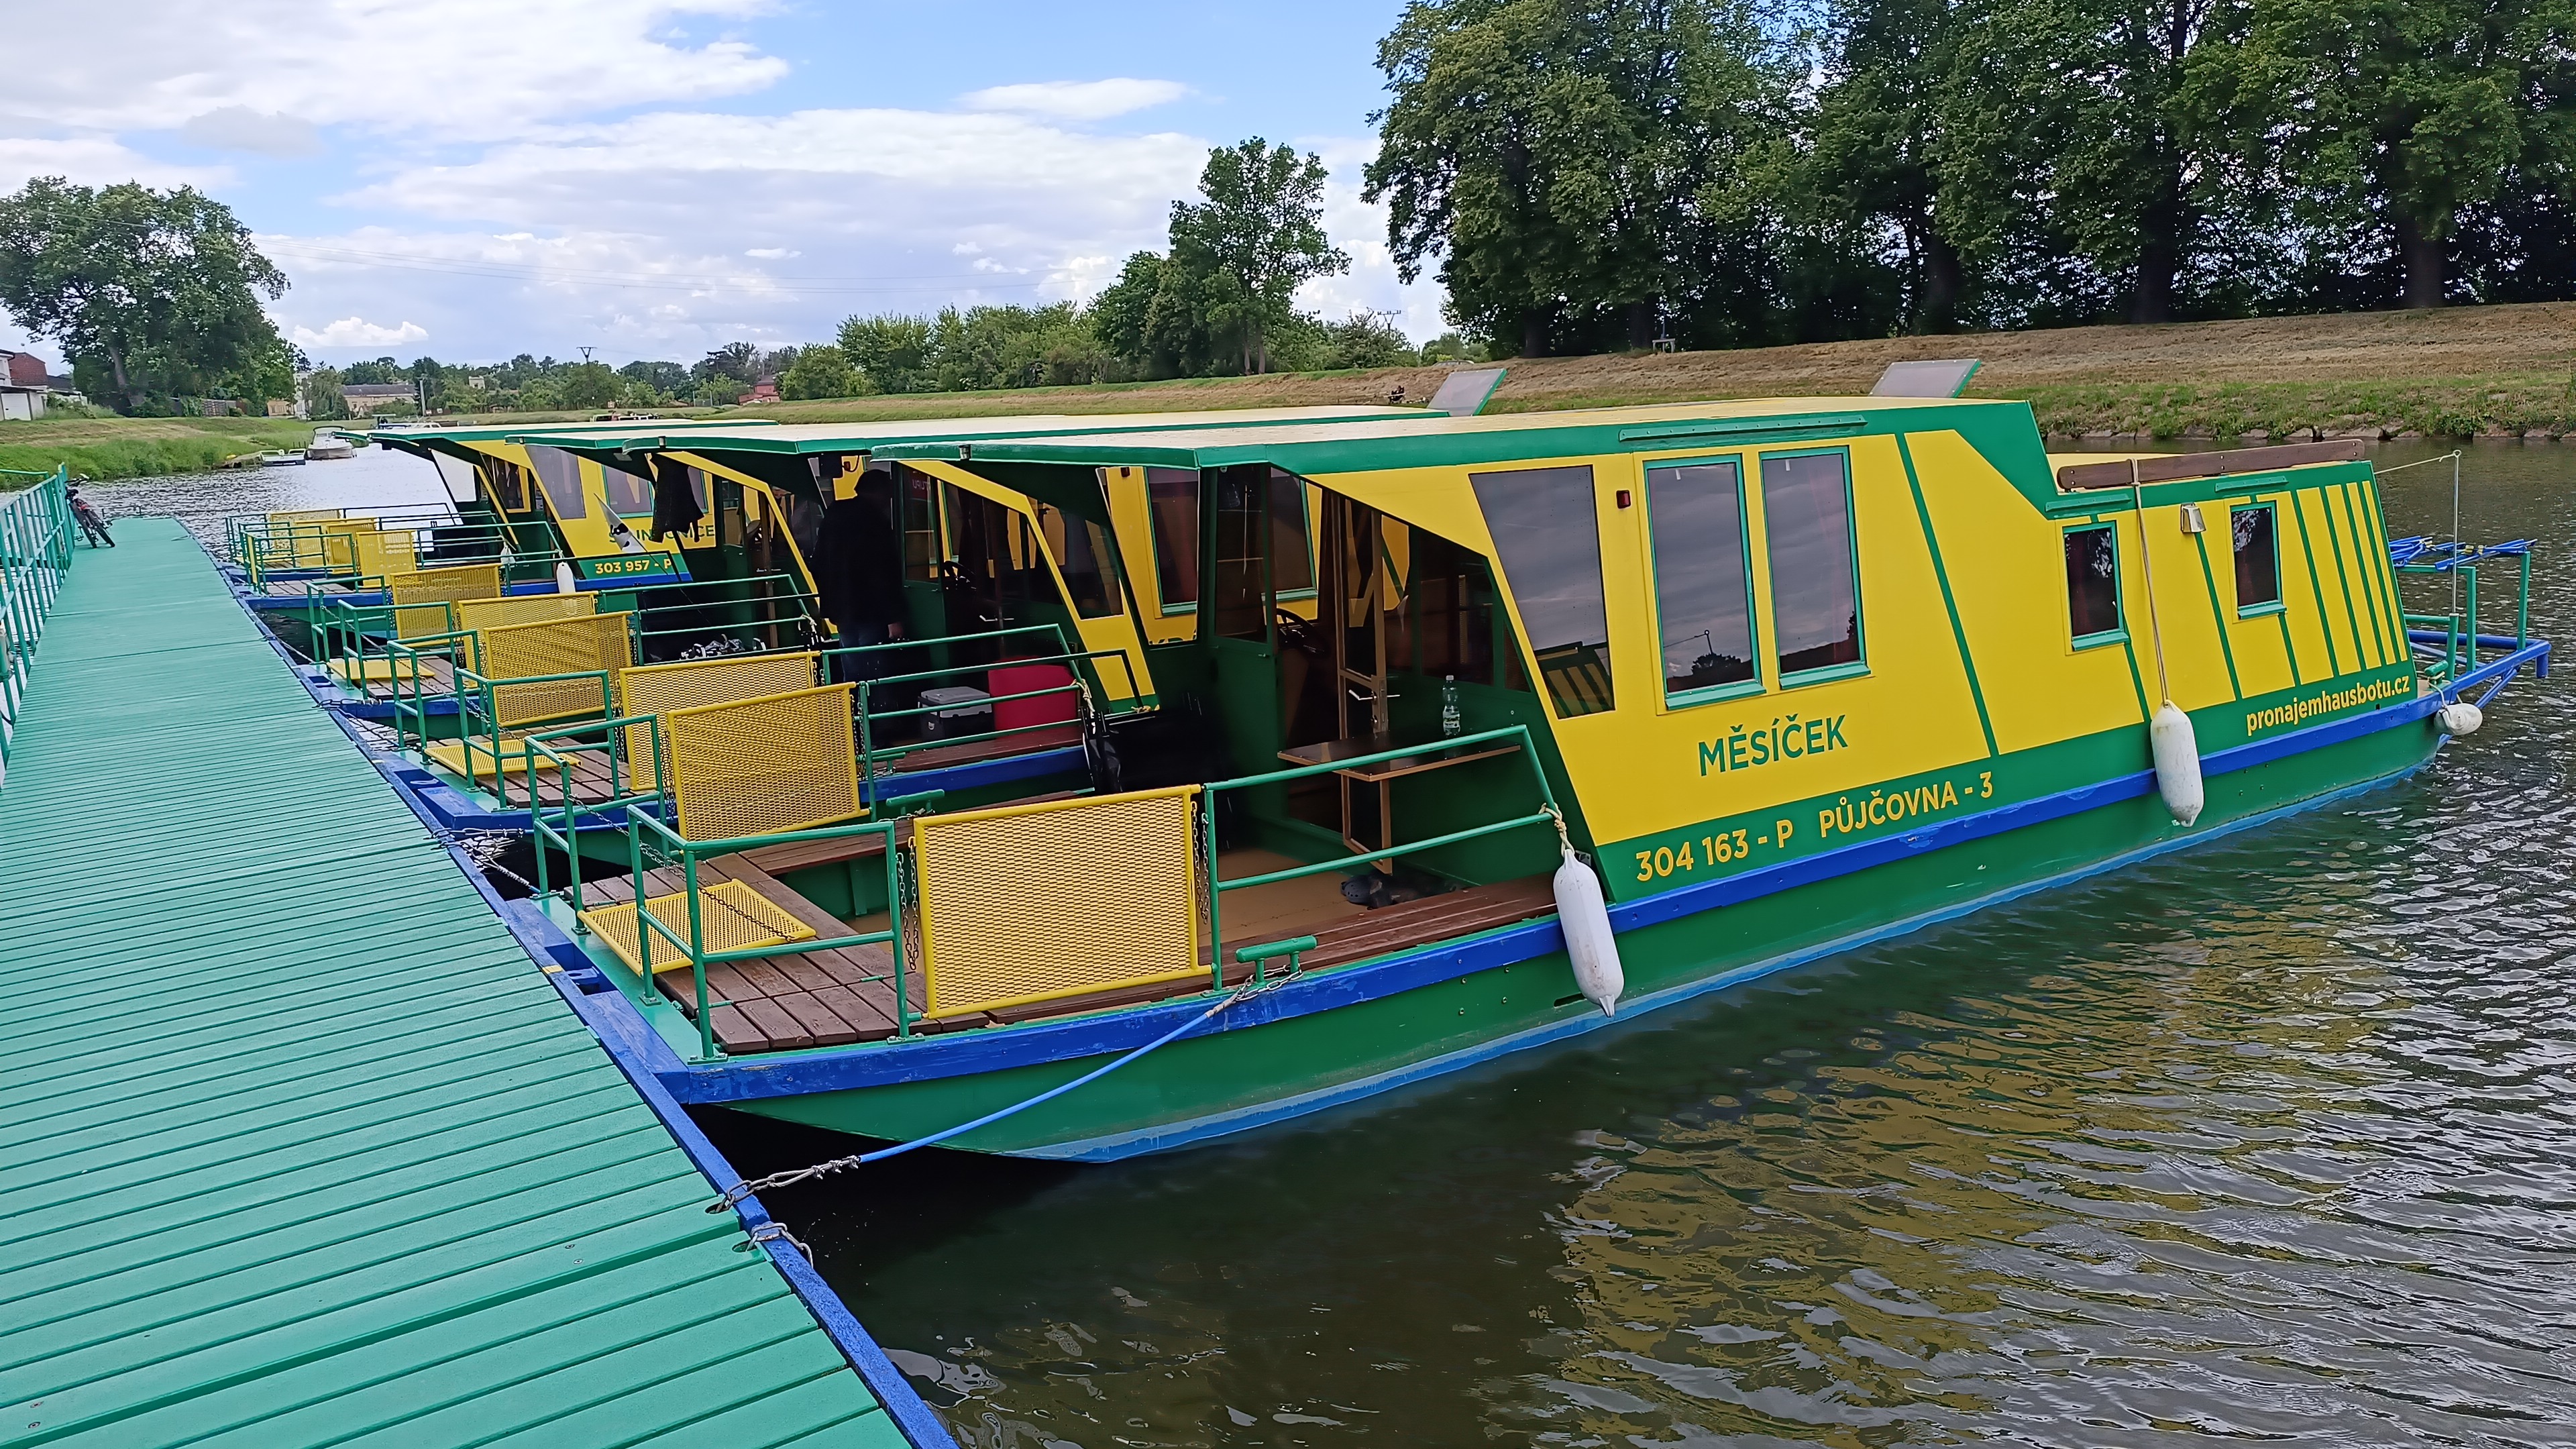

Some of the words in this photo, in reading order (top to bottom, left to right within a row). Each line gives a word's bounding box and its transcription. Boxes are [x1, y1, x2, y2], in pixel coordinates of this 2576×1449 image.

[595, 562, 621, 574] 303
[625, 559, 650, 572] 957
[663, 558, 672, 569] P
[2247, 675, 2410, 736] pronajemhausbotu.cz
[1698, 713, 1848, 777] MĚSÍČEK
[1636, 841, 1694, 881] 304
[1702, 828, 1749, 865] 163
[1758, 837, 1768, 845] -
[1776, 819, 1794, 849] P
[1819, 780, 1959, 838] PŮJČOVNA
[1964, 786, 1974, 794] -
[1979, 771, 1994, 798] 3
